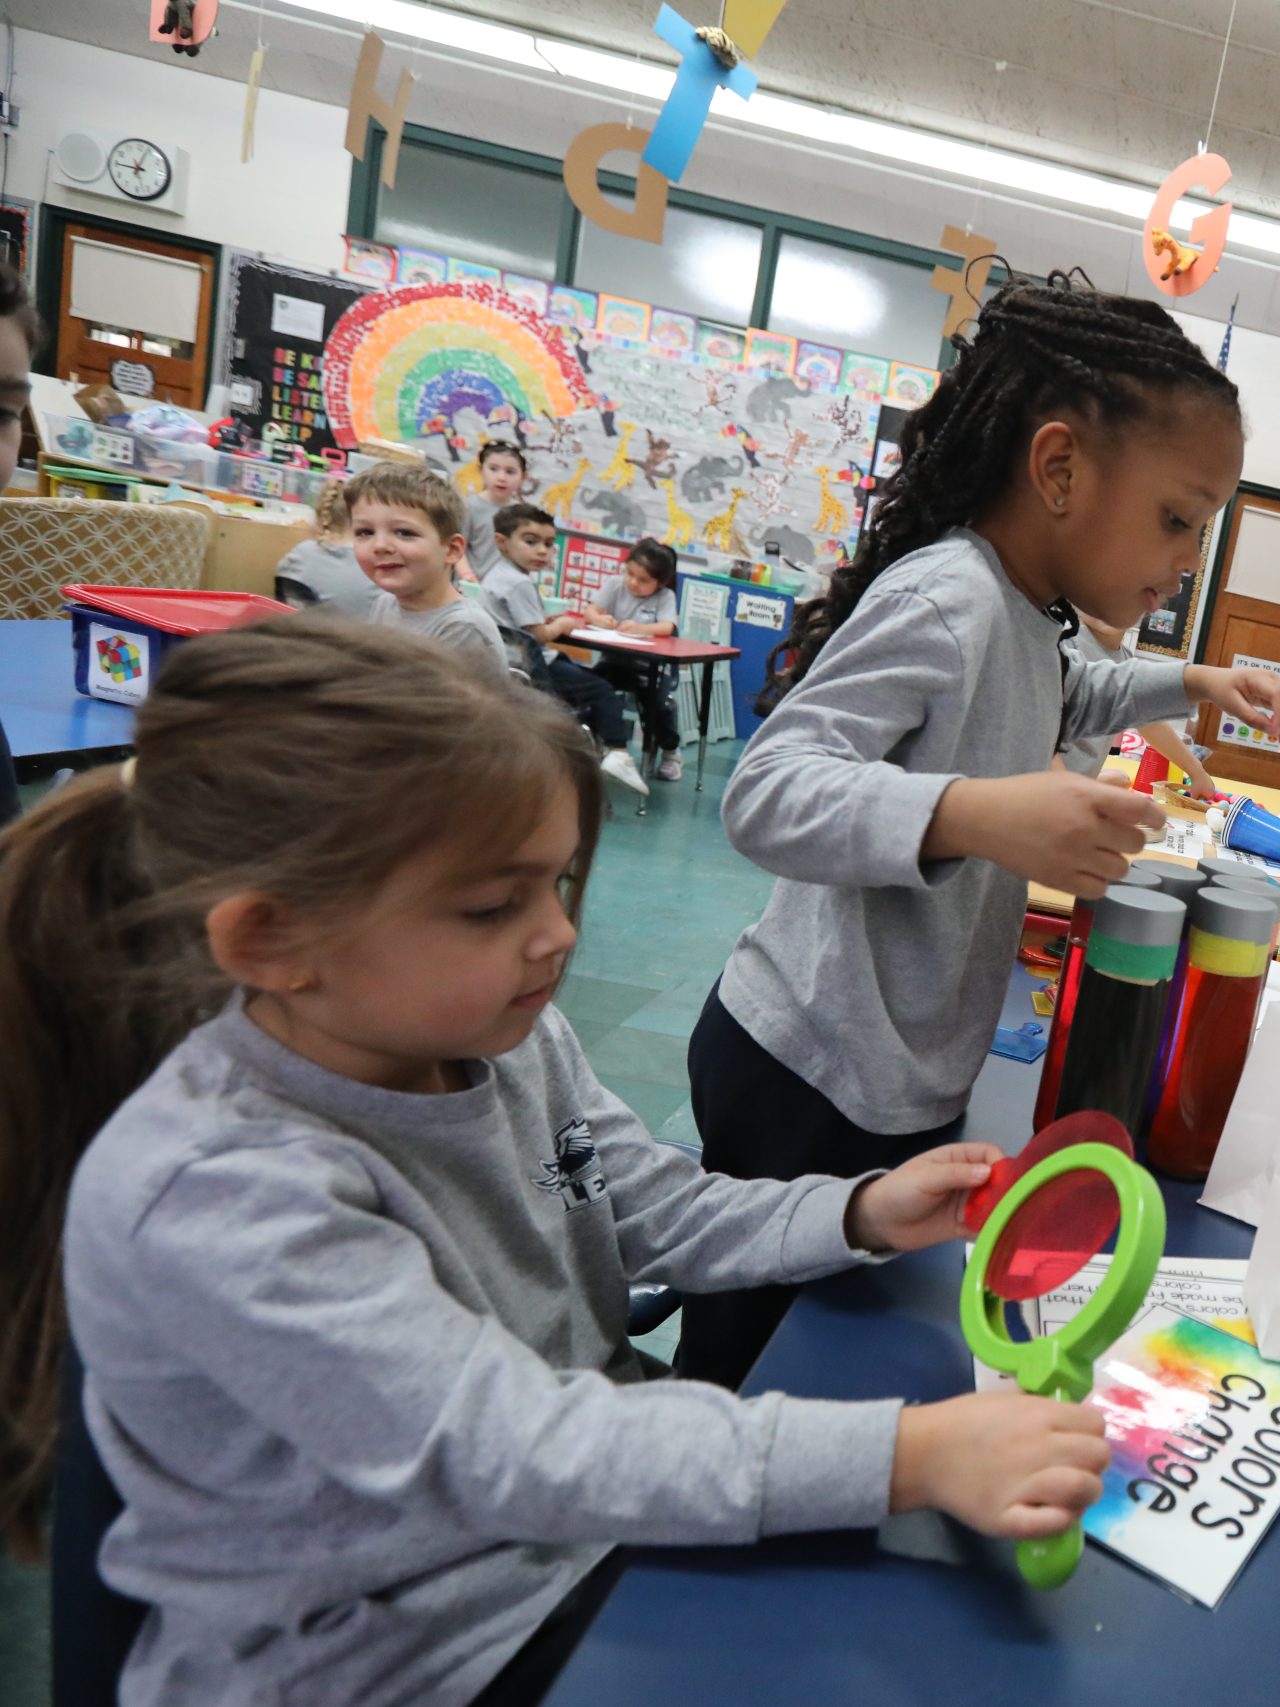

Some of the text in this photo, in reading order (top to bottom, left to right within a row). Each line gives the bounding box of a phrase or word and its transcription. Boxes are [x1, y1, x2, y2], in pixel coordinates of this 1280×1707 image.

[1143, 152, 1232, 297] G
[1044, 1295, 1085, 1306] that
[1170, 1292, 1217, 1303] made
[1186, 1304, 1239, 1316] colors
